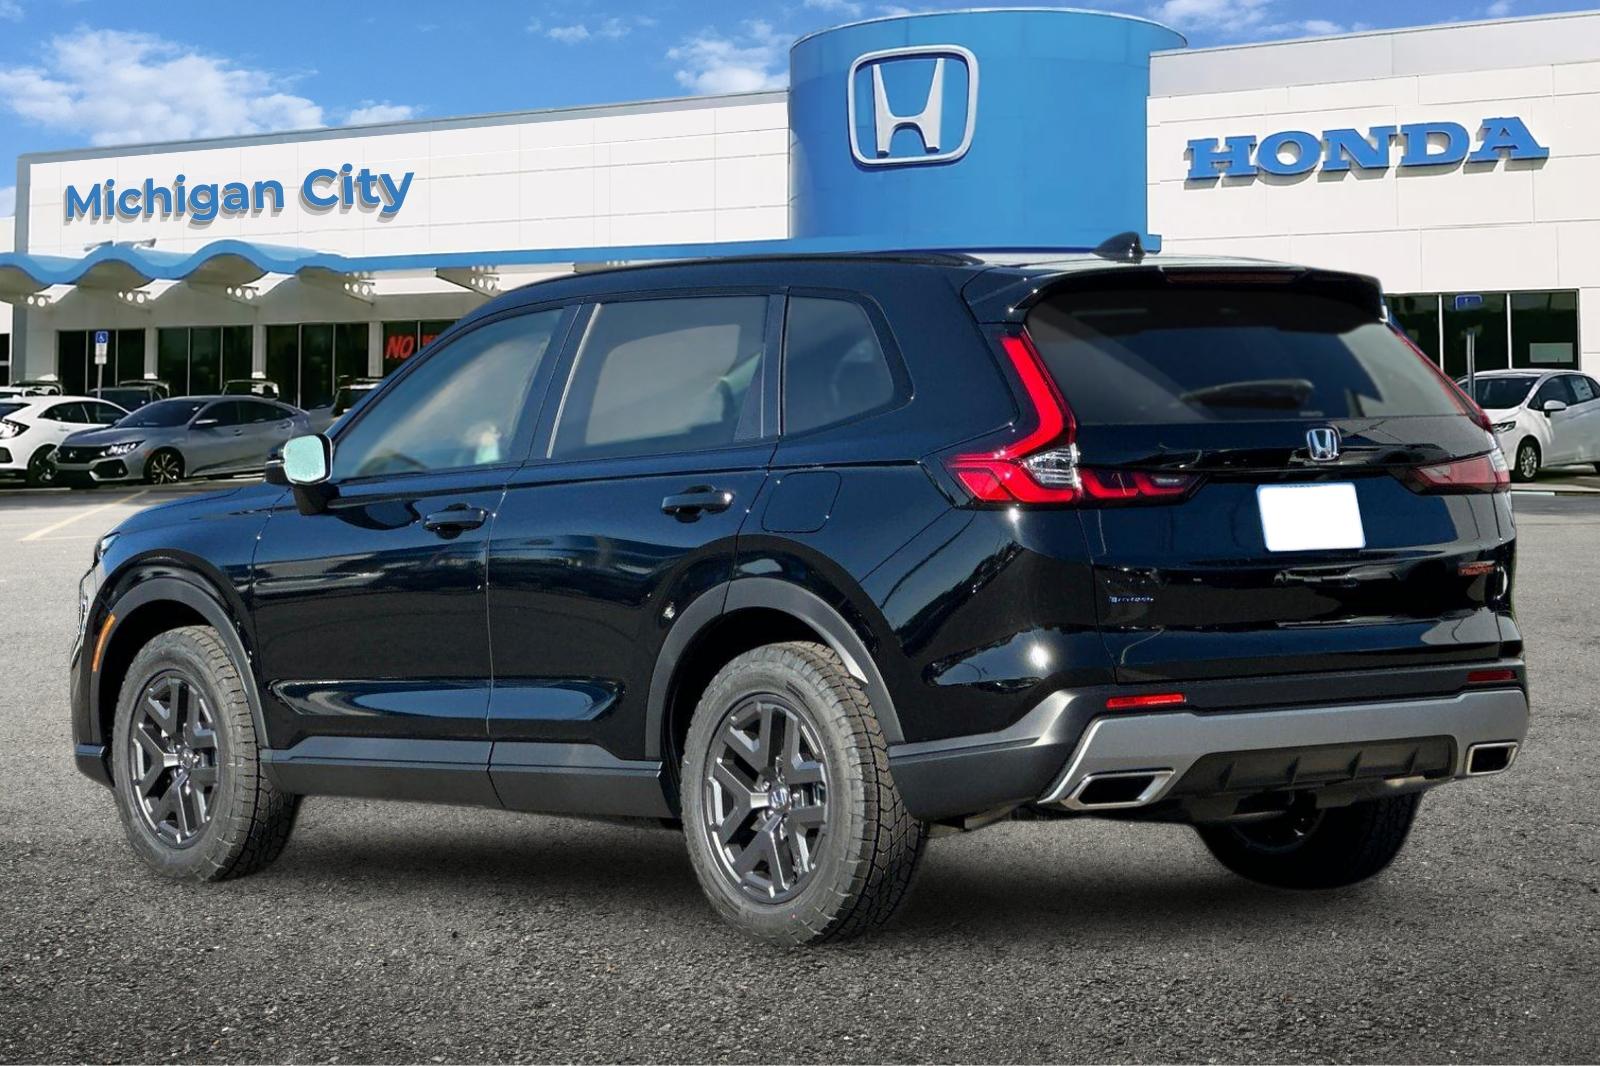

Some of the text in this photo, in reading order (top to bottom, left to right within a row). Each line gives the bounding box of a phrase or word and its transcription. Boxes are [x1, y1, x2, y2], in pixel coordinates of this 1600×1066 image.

[1186, 116, 1550, 181] HONDA
[66, 163, 415, 222] Michigan City
